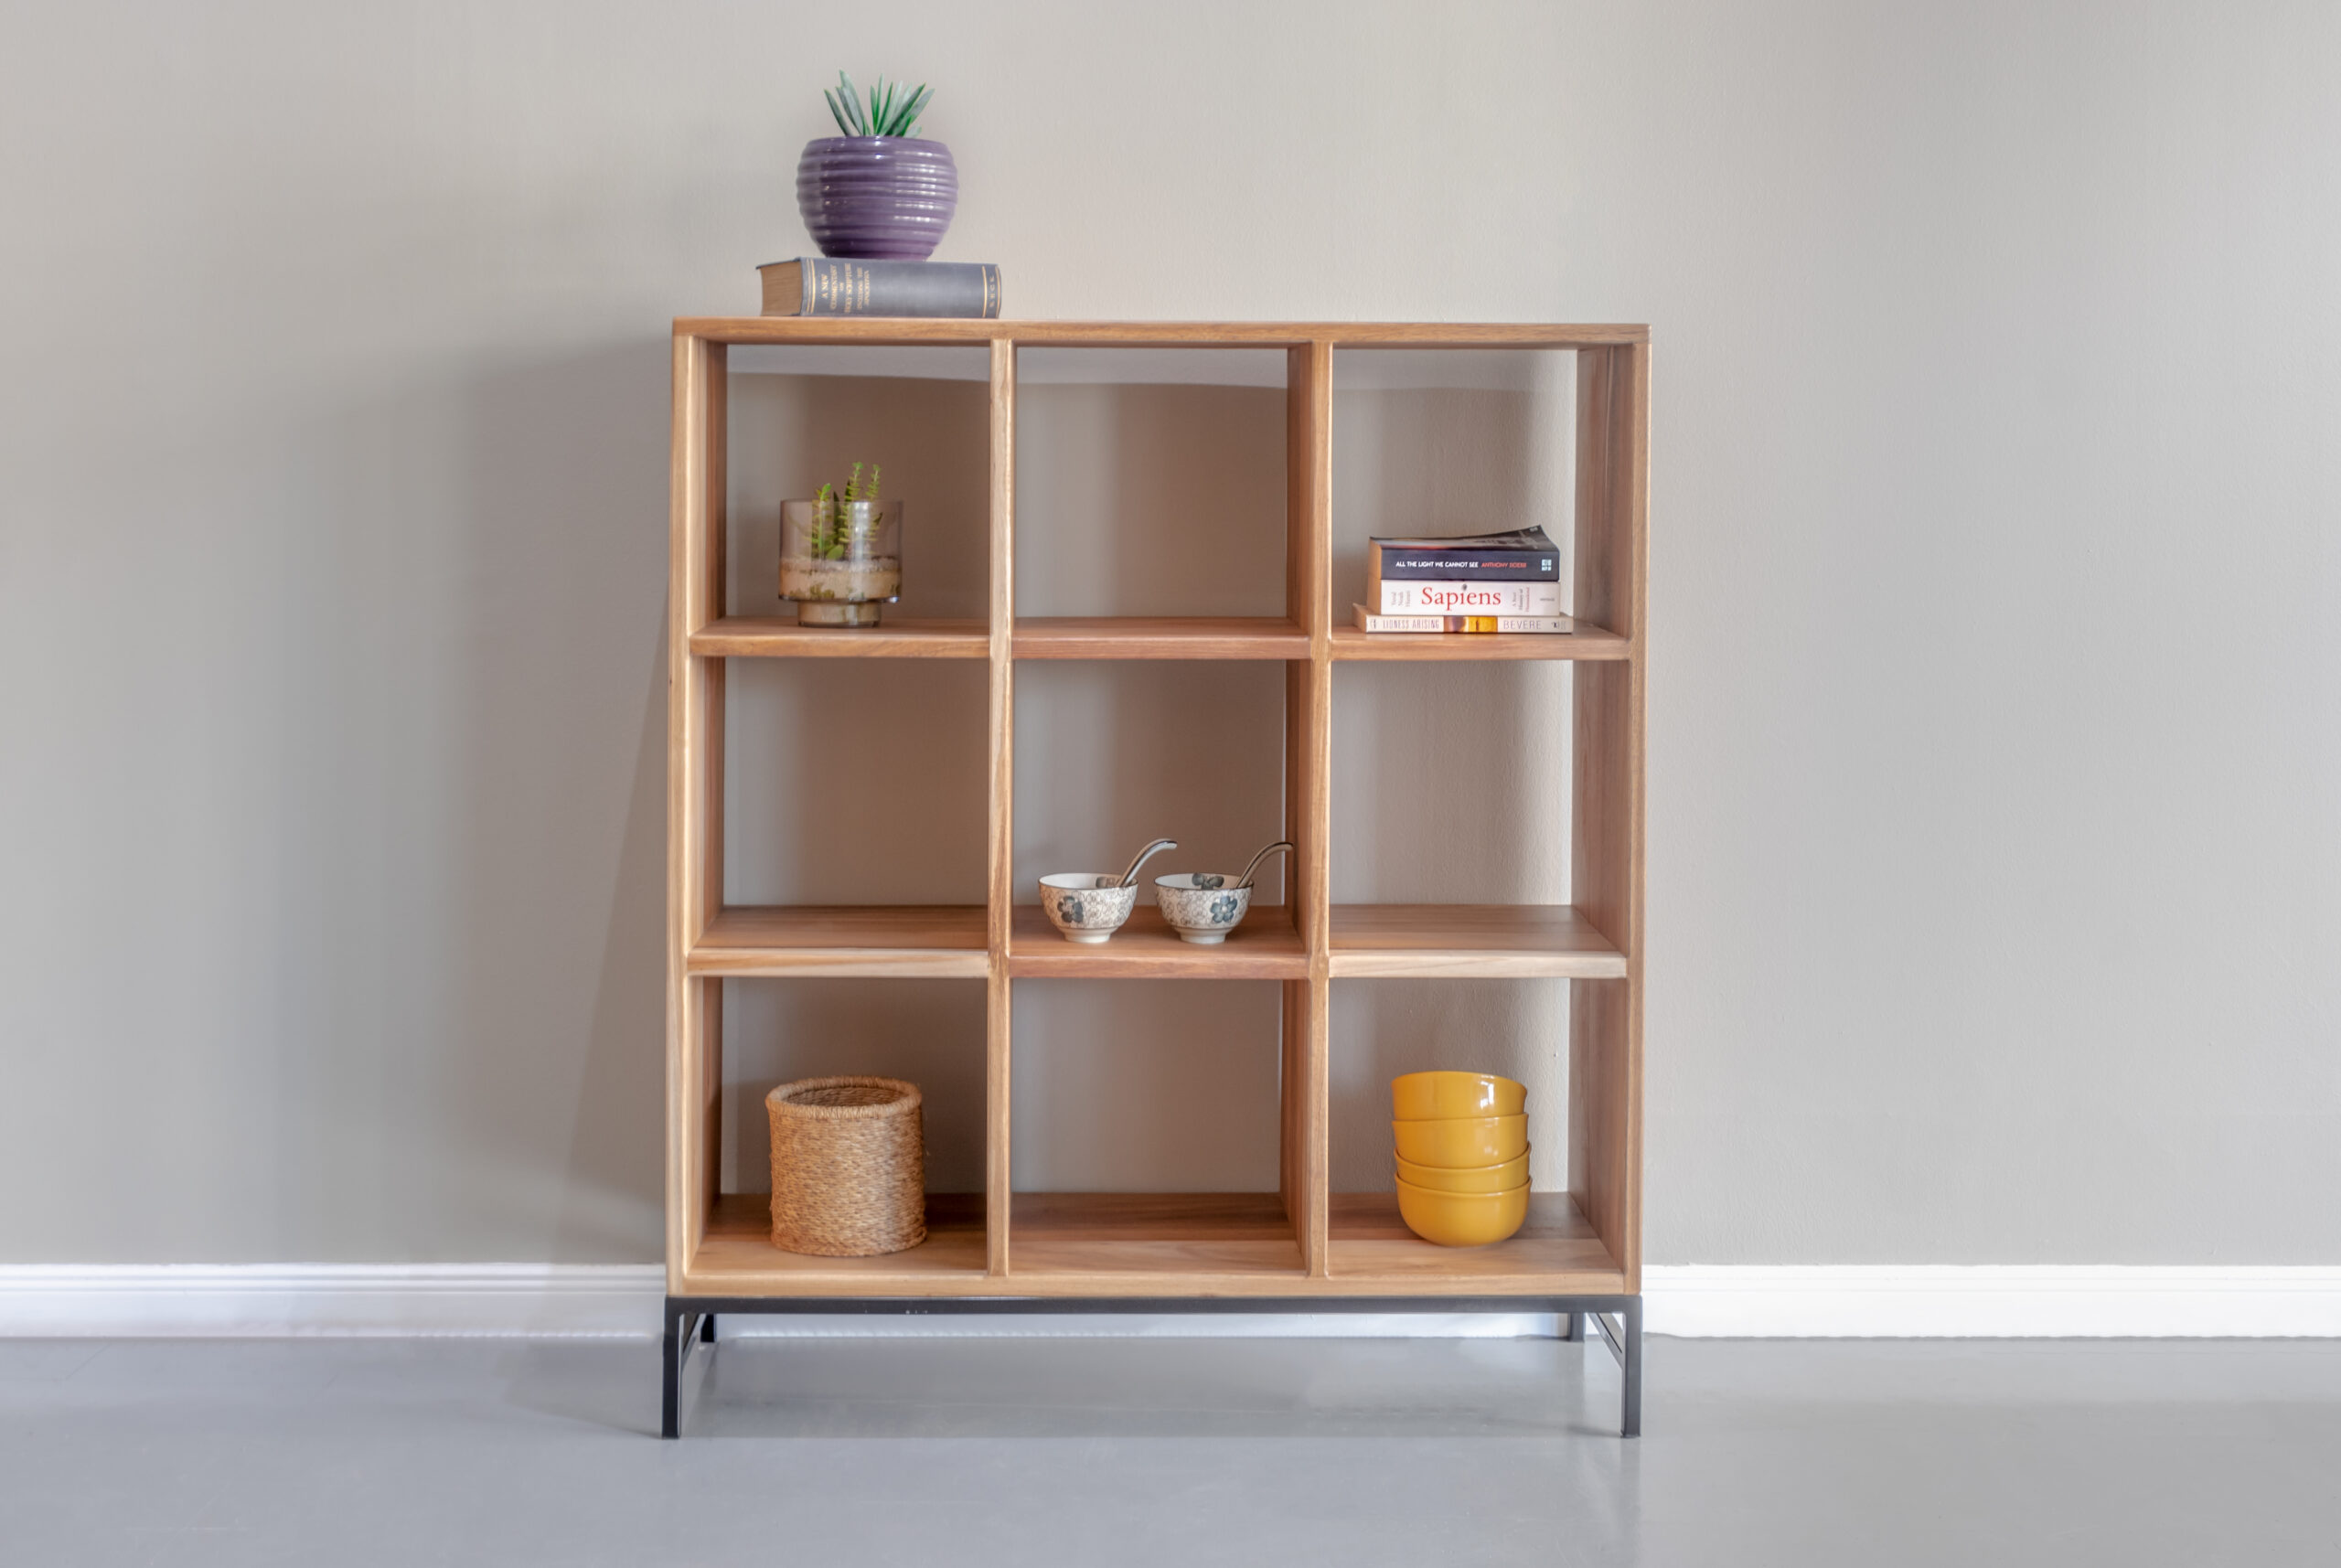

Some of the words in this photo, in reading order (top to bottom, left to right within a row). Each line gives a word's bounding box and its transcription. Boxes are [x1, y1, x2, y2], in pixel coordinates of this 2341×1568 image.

[1421, 584, 1502, 611] Sapiens
[1412, 619, 1439, 629] ARISING
[1503, 620, 1542, 630] BEVERE
